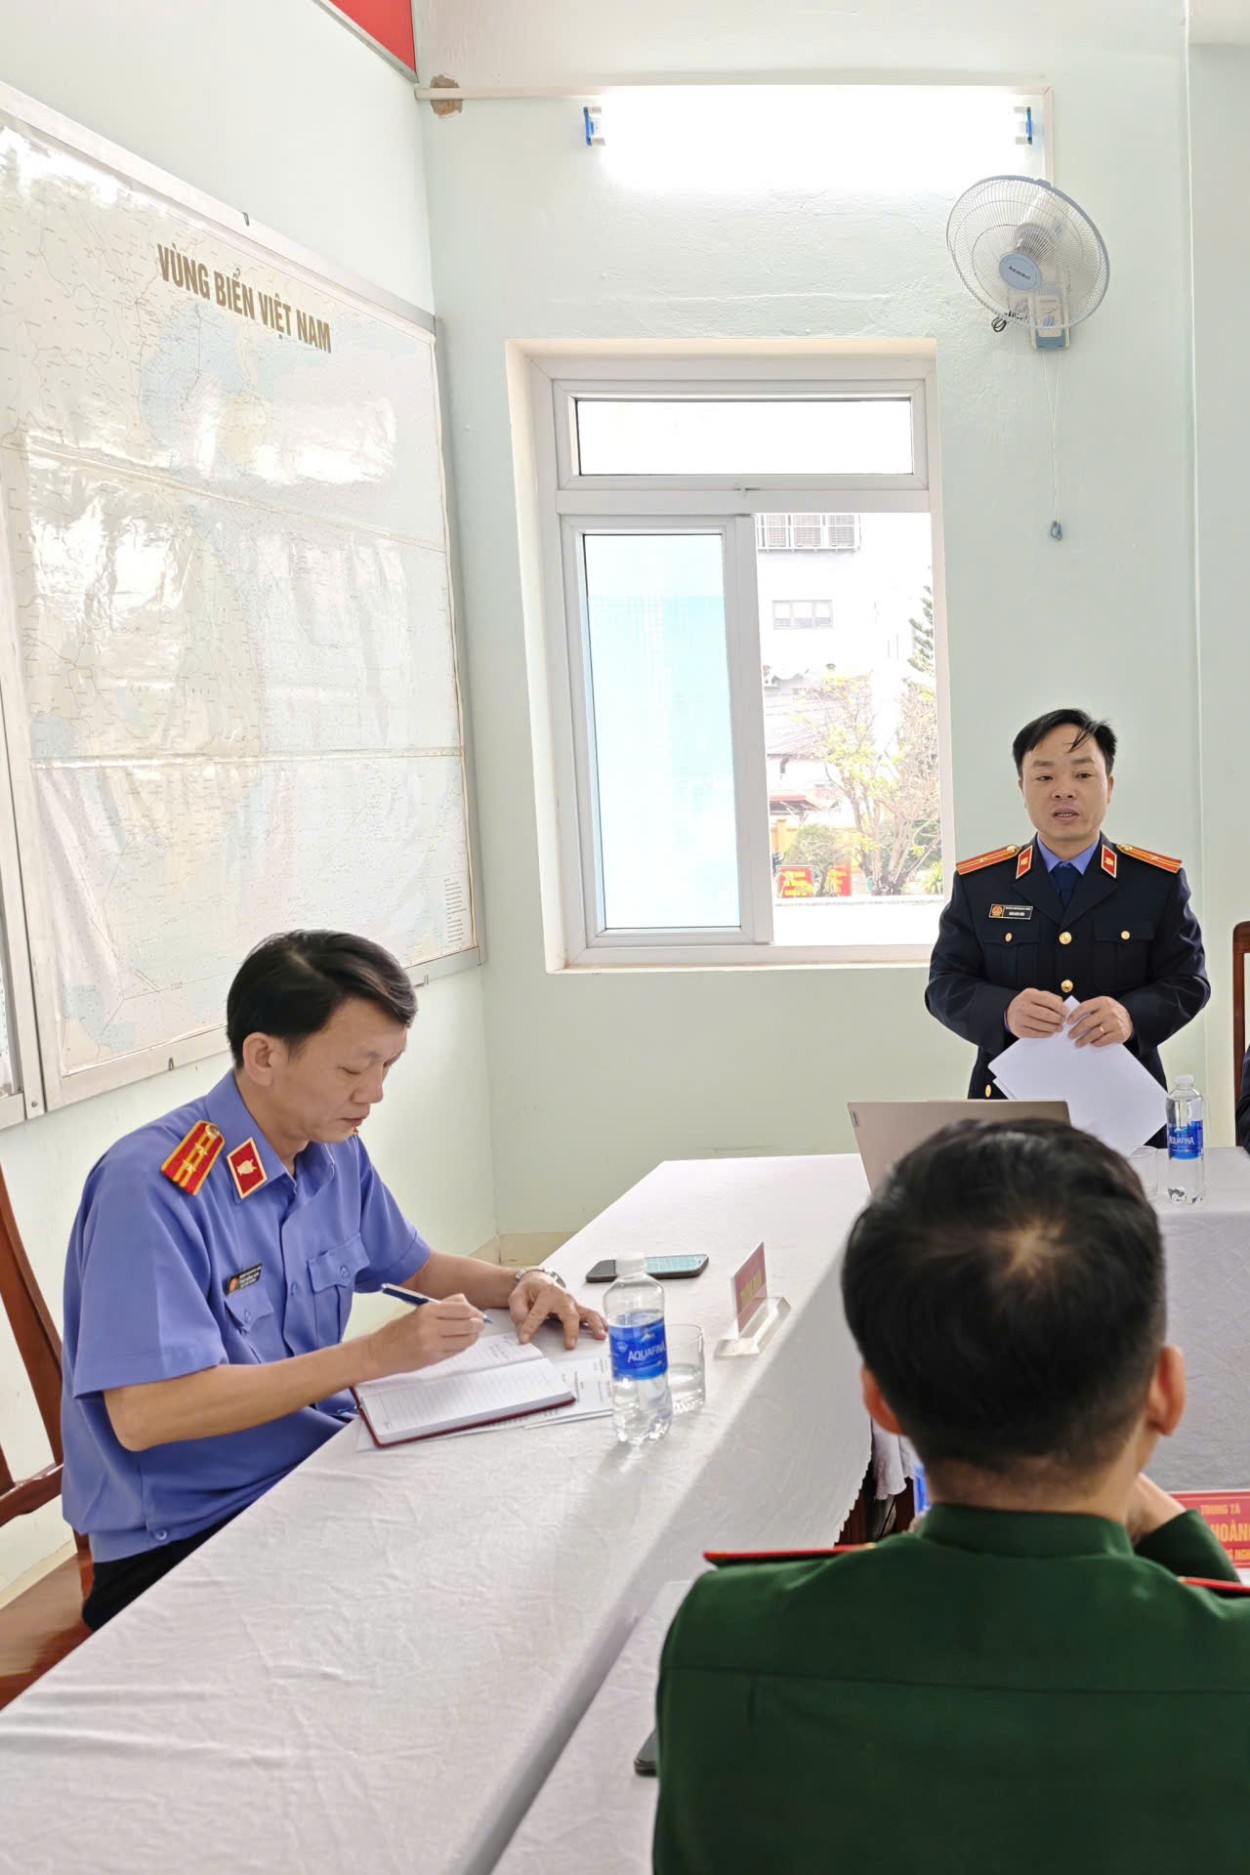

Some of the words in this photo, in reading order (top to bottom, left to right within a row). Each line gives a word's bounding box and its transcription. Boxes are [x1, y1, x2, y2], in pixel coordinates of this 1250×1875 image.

[157, 242, 211, 300] VÙNG
[213, 267, 255, 320] BIỂN
[257, 292, 292, 340] VIỆT
[295, 308, 332, 353] NAM
[1200, 1504, 1228, 1515] TRUNG
[1229, 1502, 1241, 1515] TÁ
